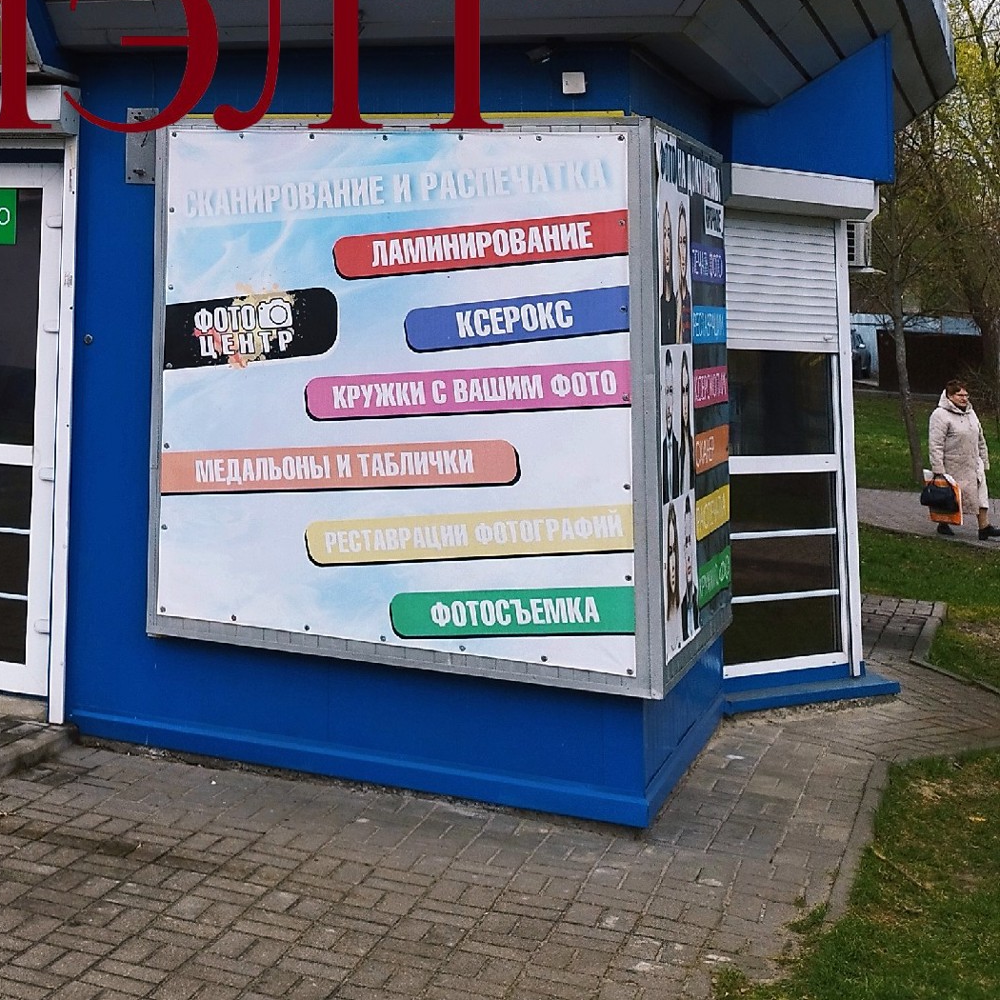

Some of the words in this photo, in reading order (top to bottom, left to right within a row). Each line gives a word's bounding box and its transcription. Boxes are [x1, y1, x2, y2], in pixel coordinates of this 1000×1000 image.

[185, 175, 385, 219] СКАНИРОВАНИЕ
[393, 173, 412, 204] И
[419, 158, 608, 201] РАСПЕЧАТКА
[372, 221, 594, 268] ЛАМИНИРОВАНИЕ
[194, 305, 256, 334] ФОТО
[455, 300, 574, 339] КСЕРОКС
[199, 330, 294, 359] ЦЕНТР
[332, 381, 426, 409] КРУЖКИ
[431, 379, 447, 404] С
[452, 374, 544, 404] ВАШИМ
[550, 370, 617, 398] ФОТО
[195, 454, 330, 484] МЕДАЛЬОНЫ
[336, 454, 351, 478] И
[357, 449, 474, 478] ТАБЛИЧКИ
[324, 523, 469, 554] РЕСТАВРАЦИИ
[475, 509, 625, 547] ФОТОГРАФИЙ
[431, 596, 601, 627] ФОТОСЪЕМКА
